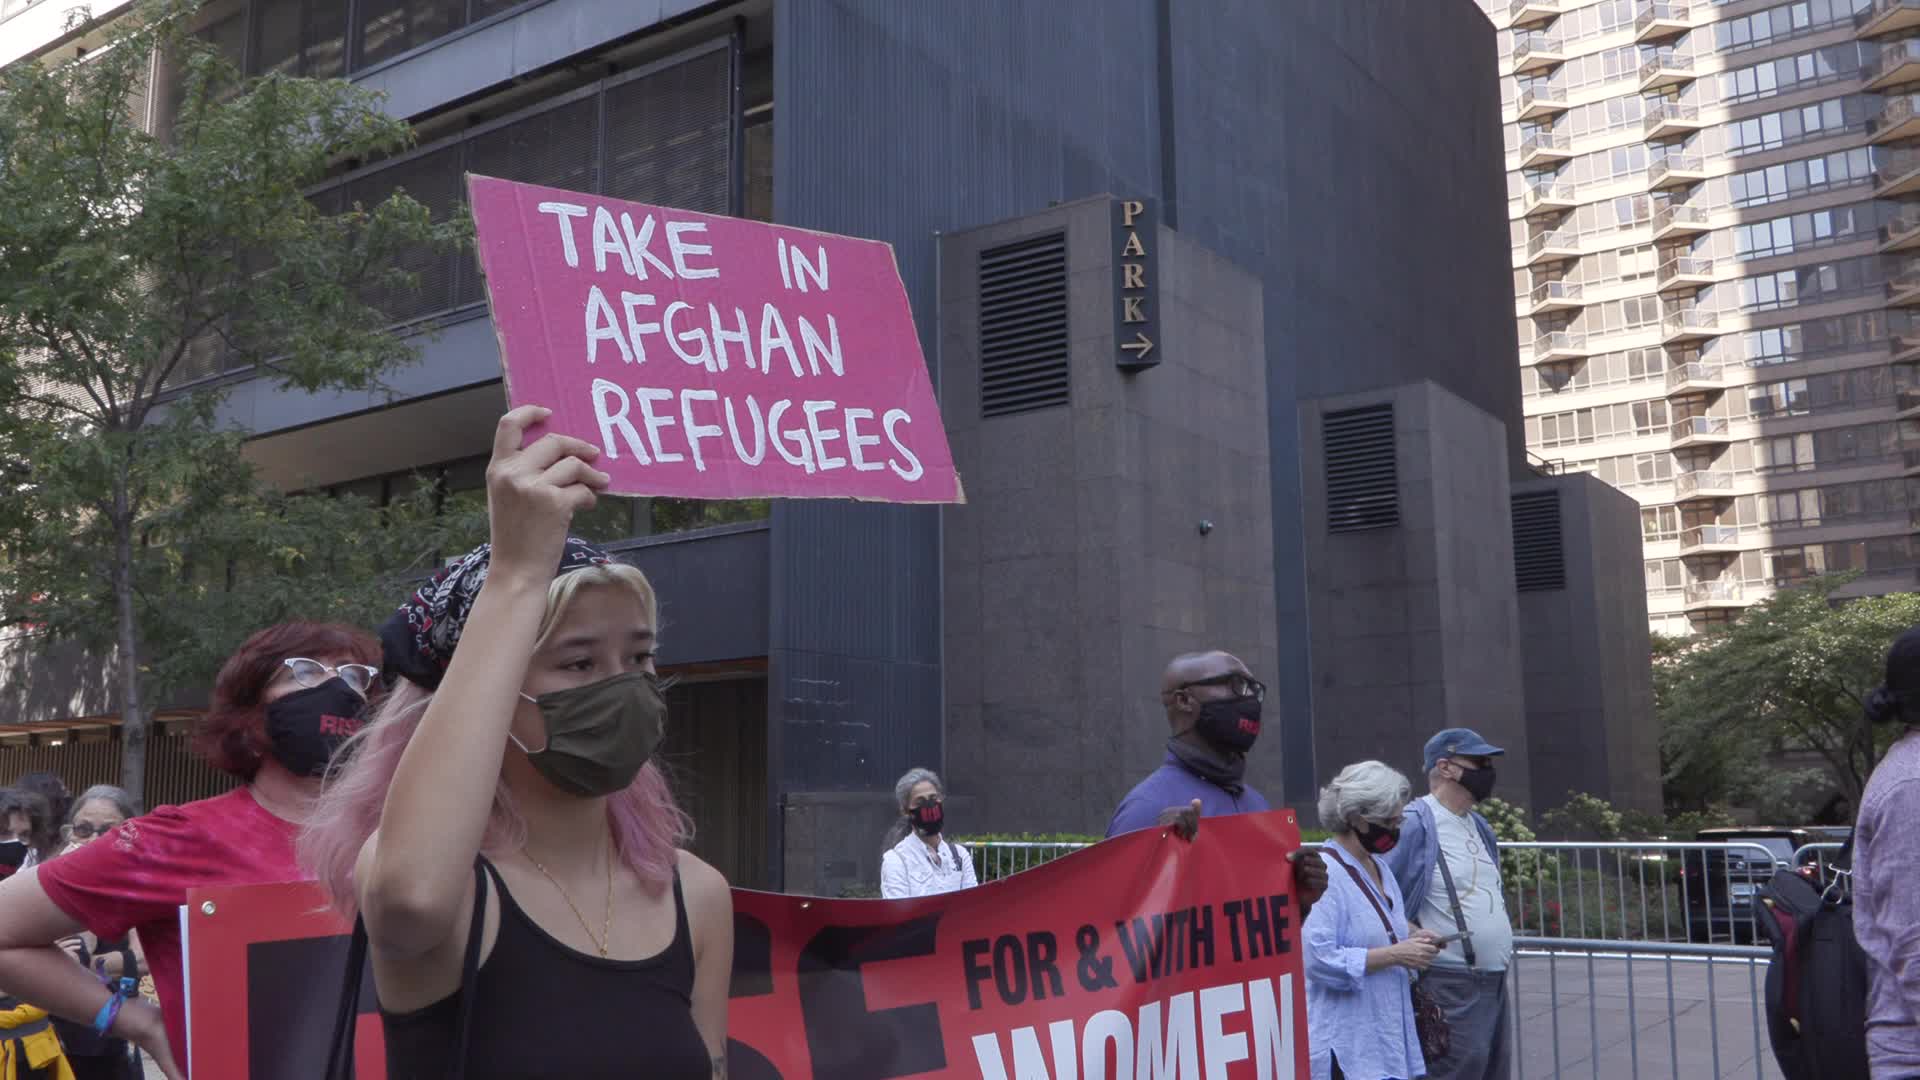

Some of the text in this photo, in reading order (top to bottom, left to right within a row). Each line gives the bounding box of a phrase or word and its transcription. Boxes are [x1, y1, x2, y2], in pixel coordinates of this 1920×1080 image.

[538, 202, 829, 293] TAKE IN
[1120, 201, 1147, 322] PARK
[585, 286, 843, 377] AFGHAN
[591, 379, 924, 482] REFUGEES
[963, 932, 1064, 1010] FOR
[1076, 924, 1116, 992] &
[1118, 906, 1215, 982] WITH
[1224, 895, 1291, 961] THE
